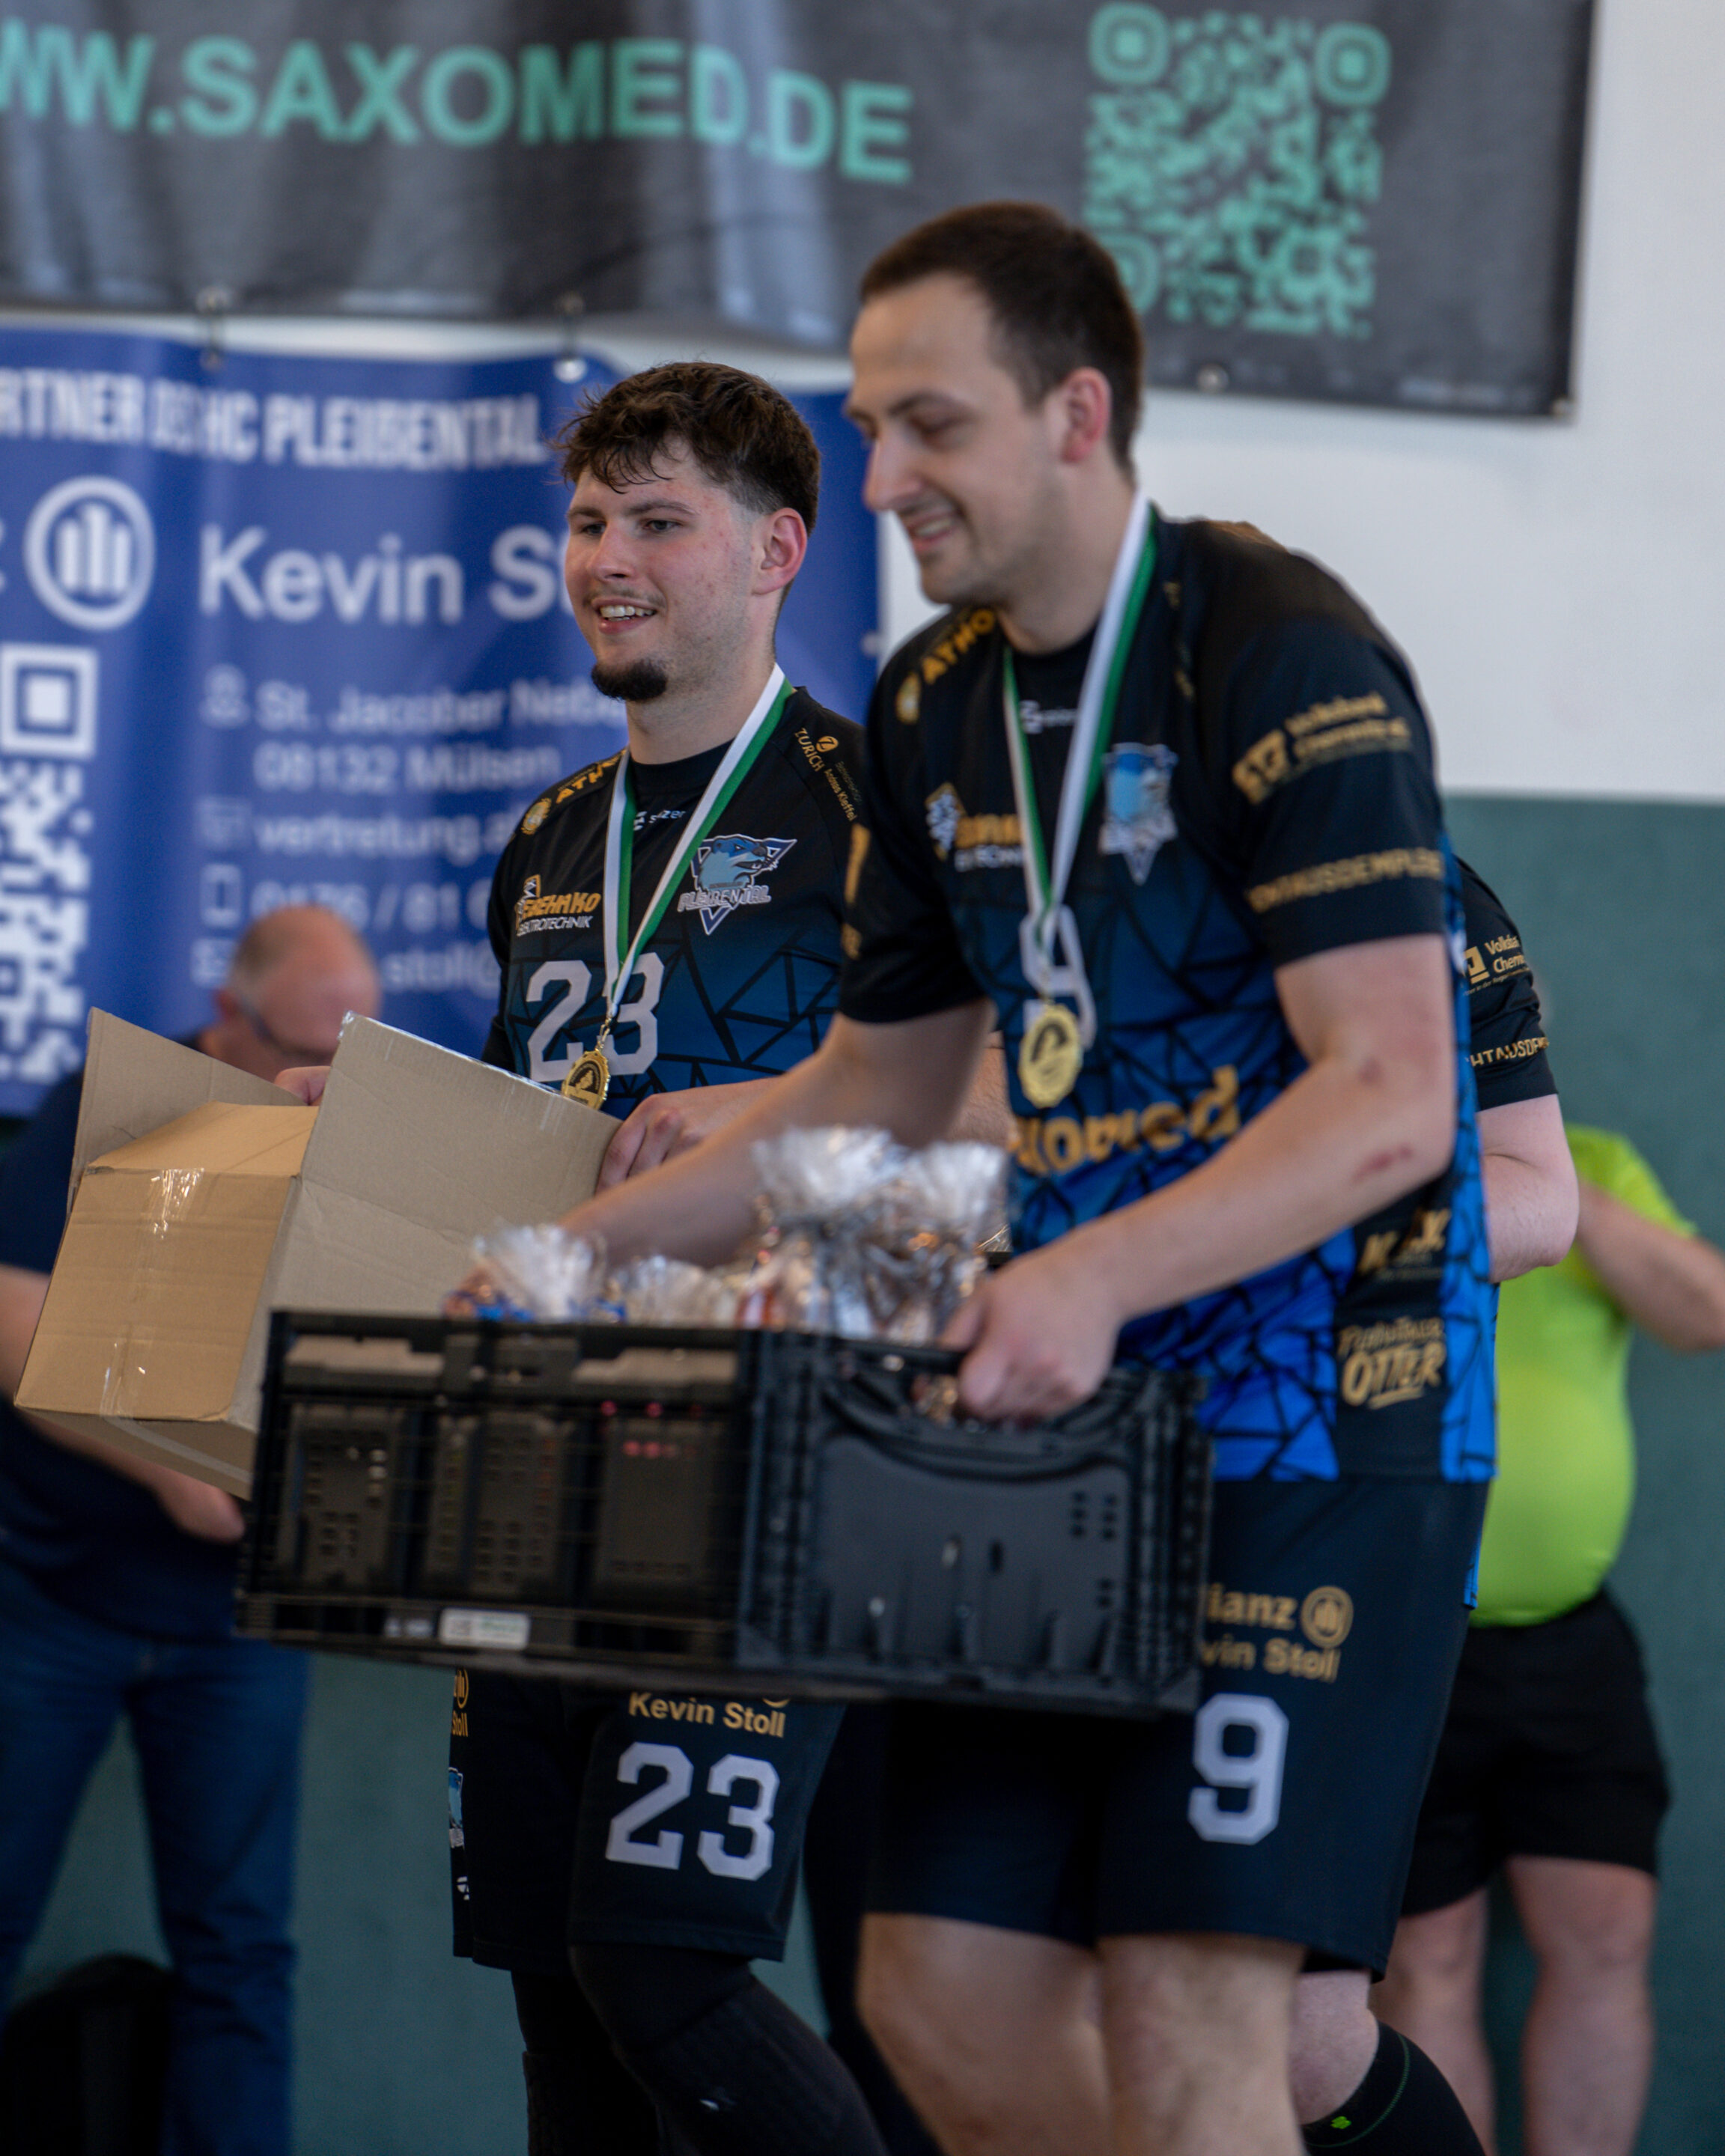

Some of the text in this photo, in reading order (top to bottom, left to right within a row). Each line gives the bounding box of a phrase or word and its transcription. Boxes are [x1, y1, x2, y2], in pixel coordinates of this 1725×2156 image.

[199, 525, 464, 624] Kevin
[794, 727, 825, 772] ZURICH
[526, 951, 665, 1083] 23
[1263, 1636, 1341, 1684] Stoll
[627, 1691, 786, 1738] Kevin Stoll
[605, 1741, 781, 1882] 23
[1187, 1693, 1289, 1846] 9
